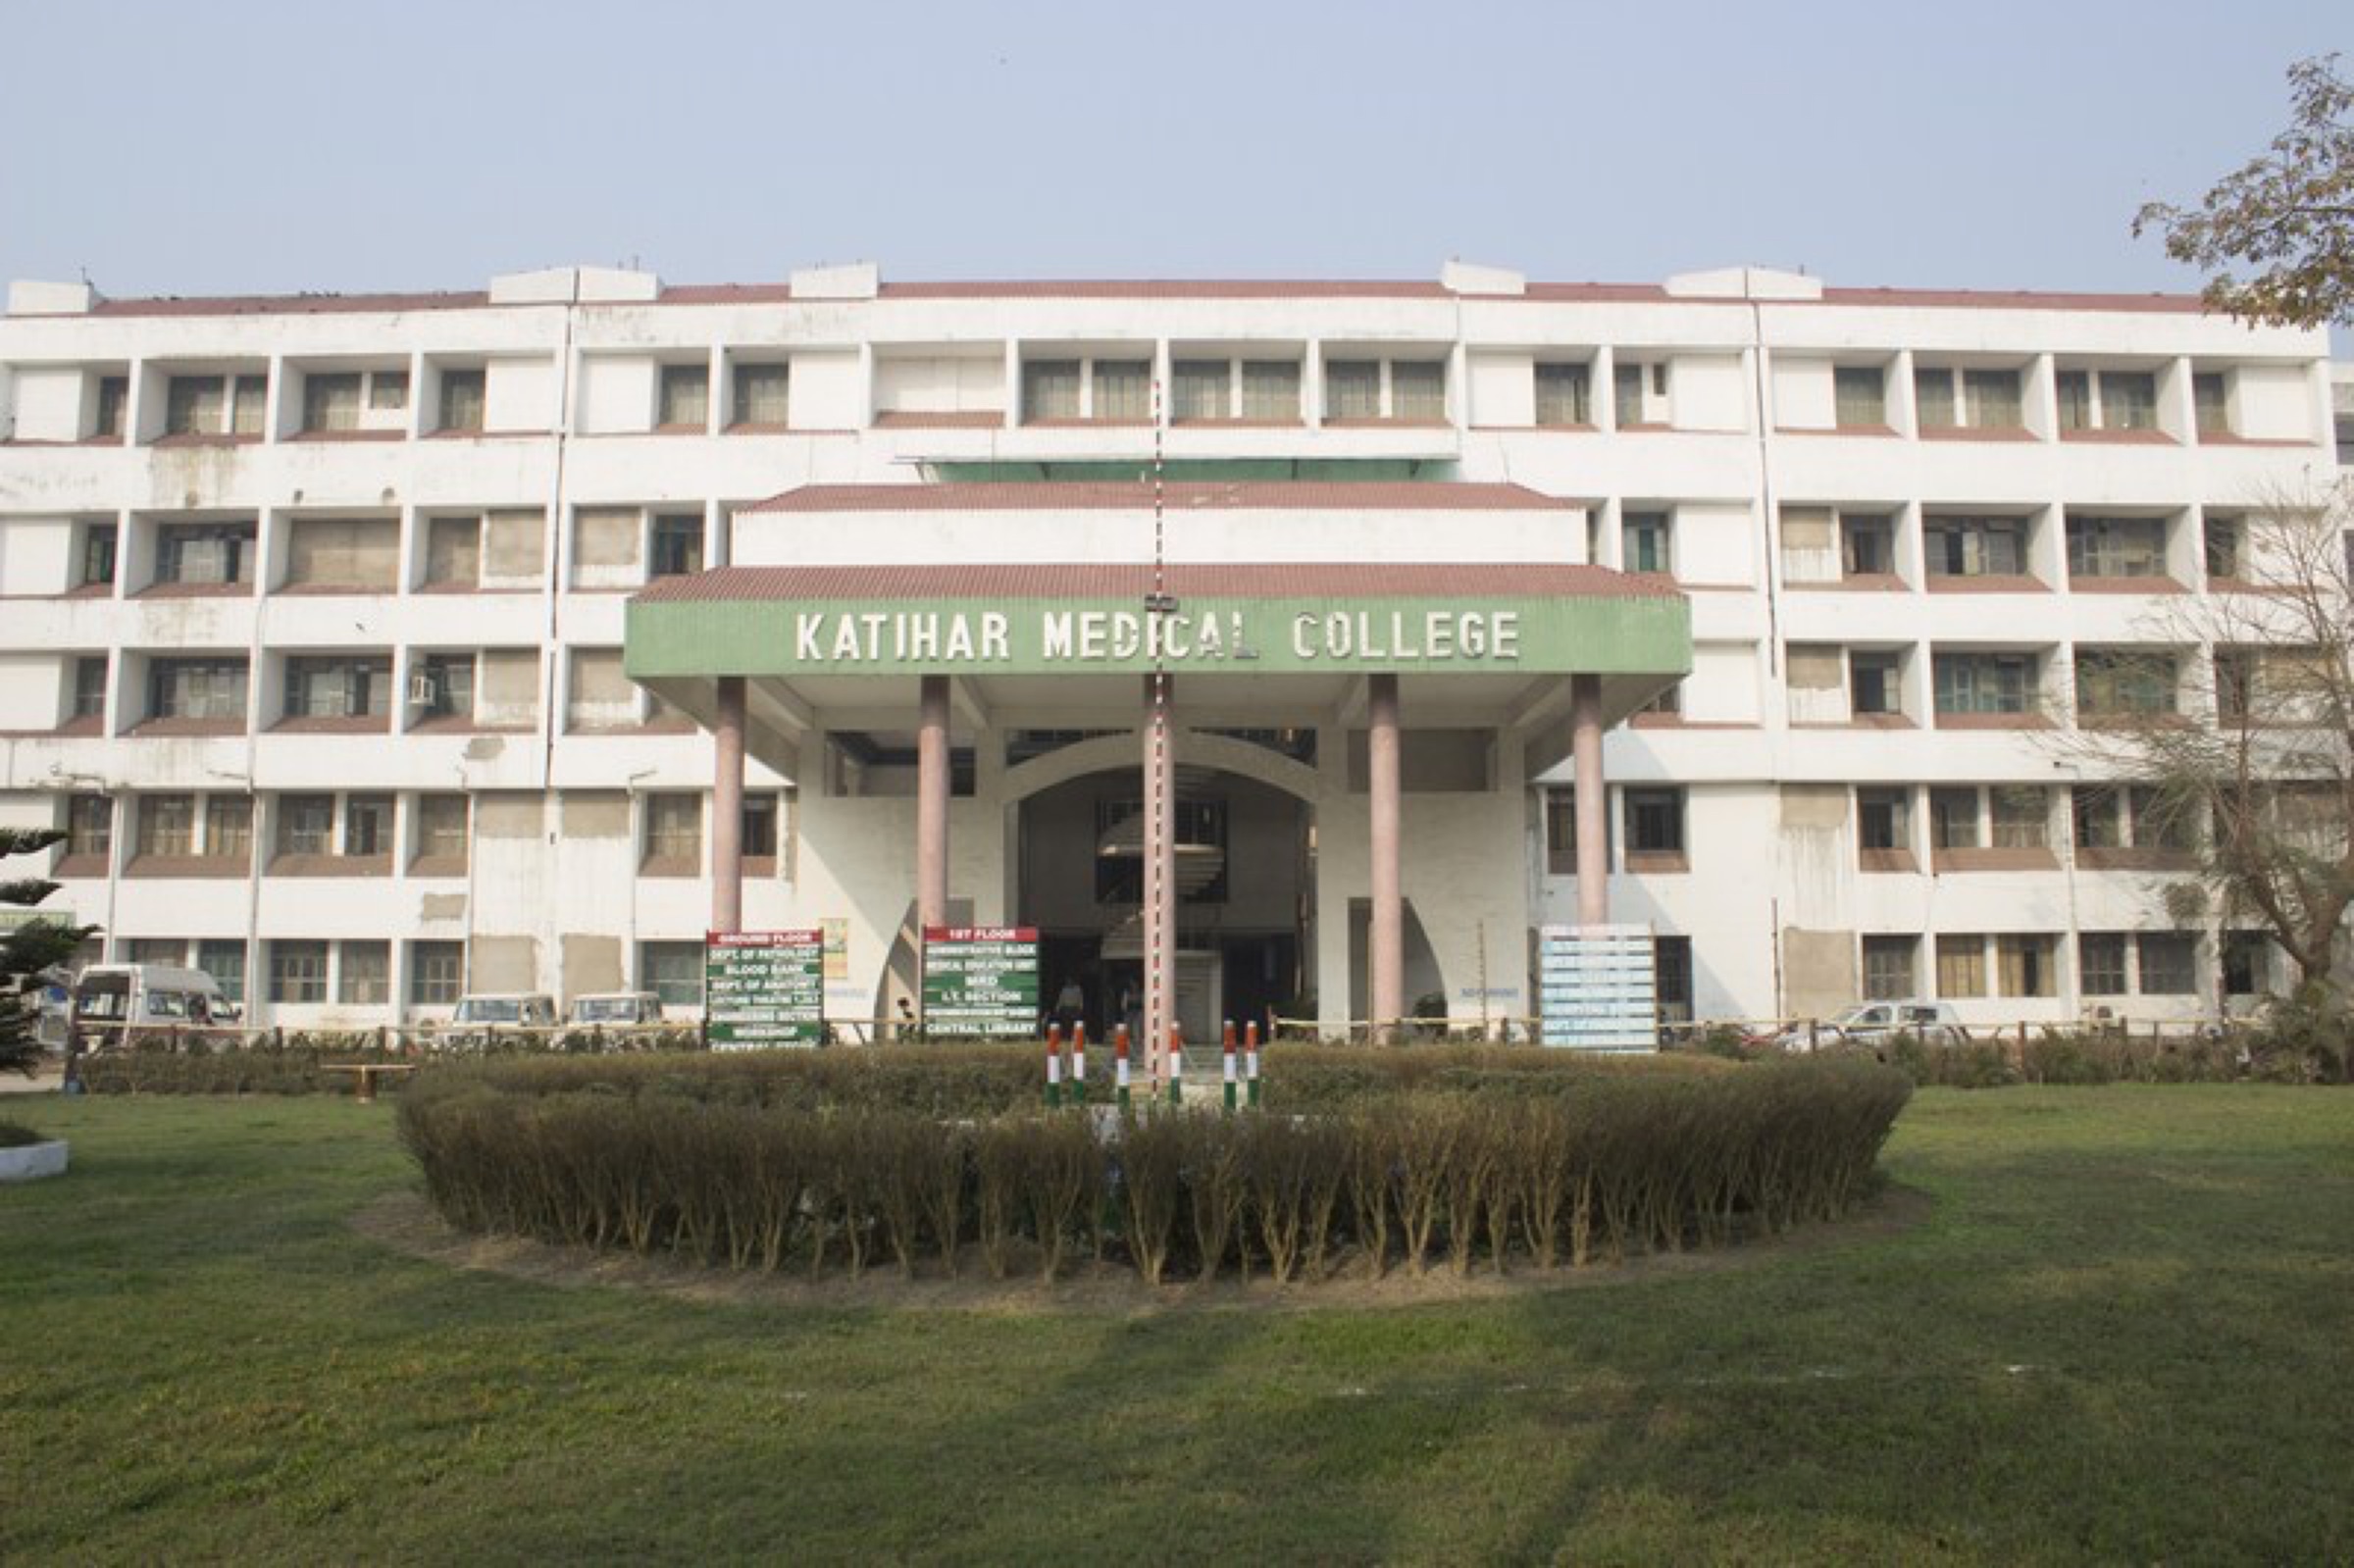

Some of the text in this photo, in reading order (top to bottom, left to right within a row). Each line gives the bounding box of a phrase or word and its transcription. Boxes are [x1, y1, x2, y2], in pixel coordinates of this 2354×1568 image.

[796, 611, 1518, 660] KATIHAR MEDICAL COLLEGE
[773, 933, 812, 942] FLOOR
[949, 929, 1016, 939] 1ST FLOOR
[741, 949, 755, 959] OF
[726, 964, 805, 975] BLOOD BANK
[745, 979, 760, 989] OF
[964, 990, 1022, 1001] SECTION
[926, 1023, 1037, 1034] CENTRAL LIBRARY
